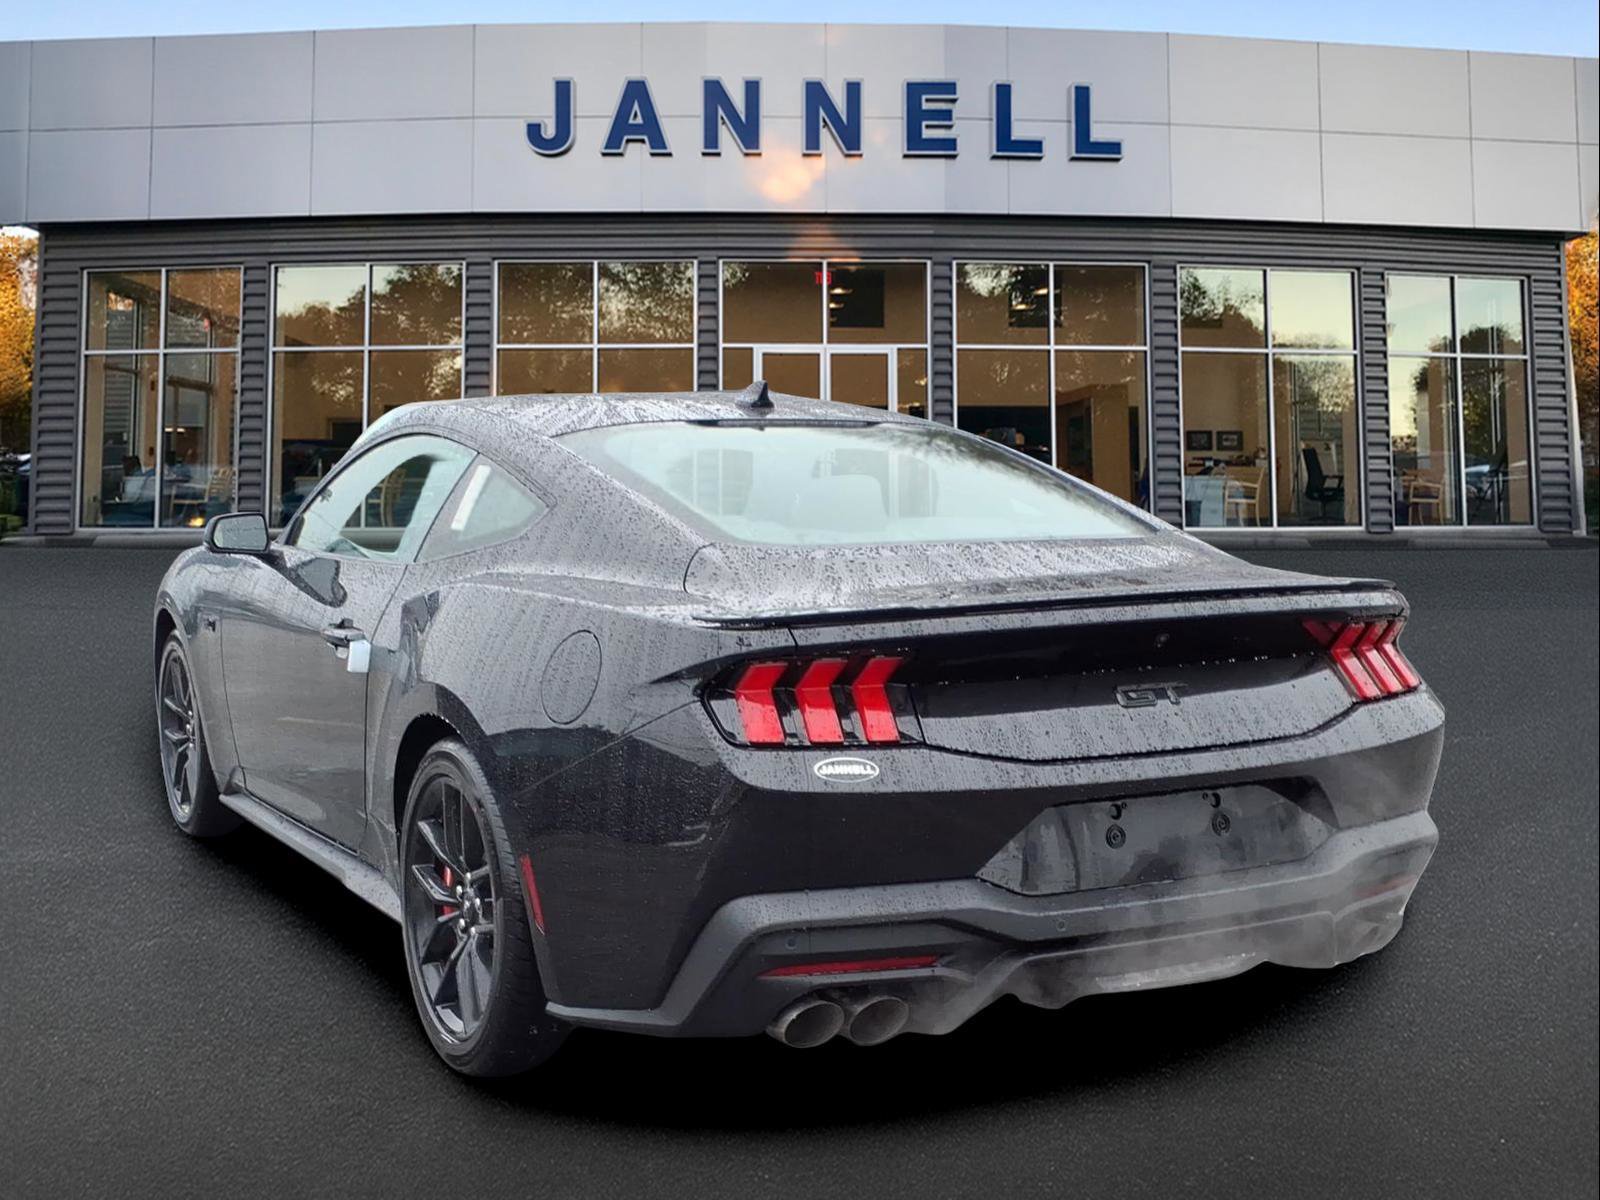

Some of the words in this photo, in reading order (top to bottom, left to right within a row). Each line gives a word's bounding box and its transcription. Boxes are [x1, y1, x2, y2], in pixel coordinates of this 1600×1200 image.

[525, 76, 1124, 161] JANNELL
[1114, 682, 1188, 708] GT
[819, 764, 875, 775] JANNELL
